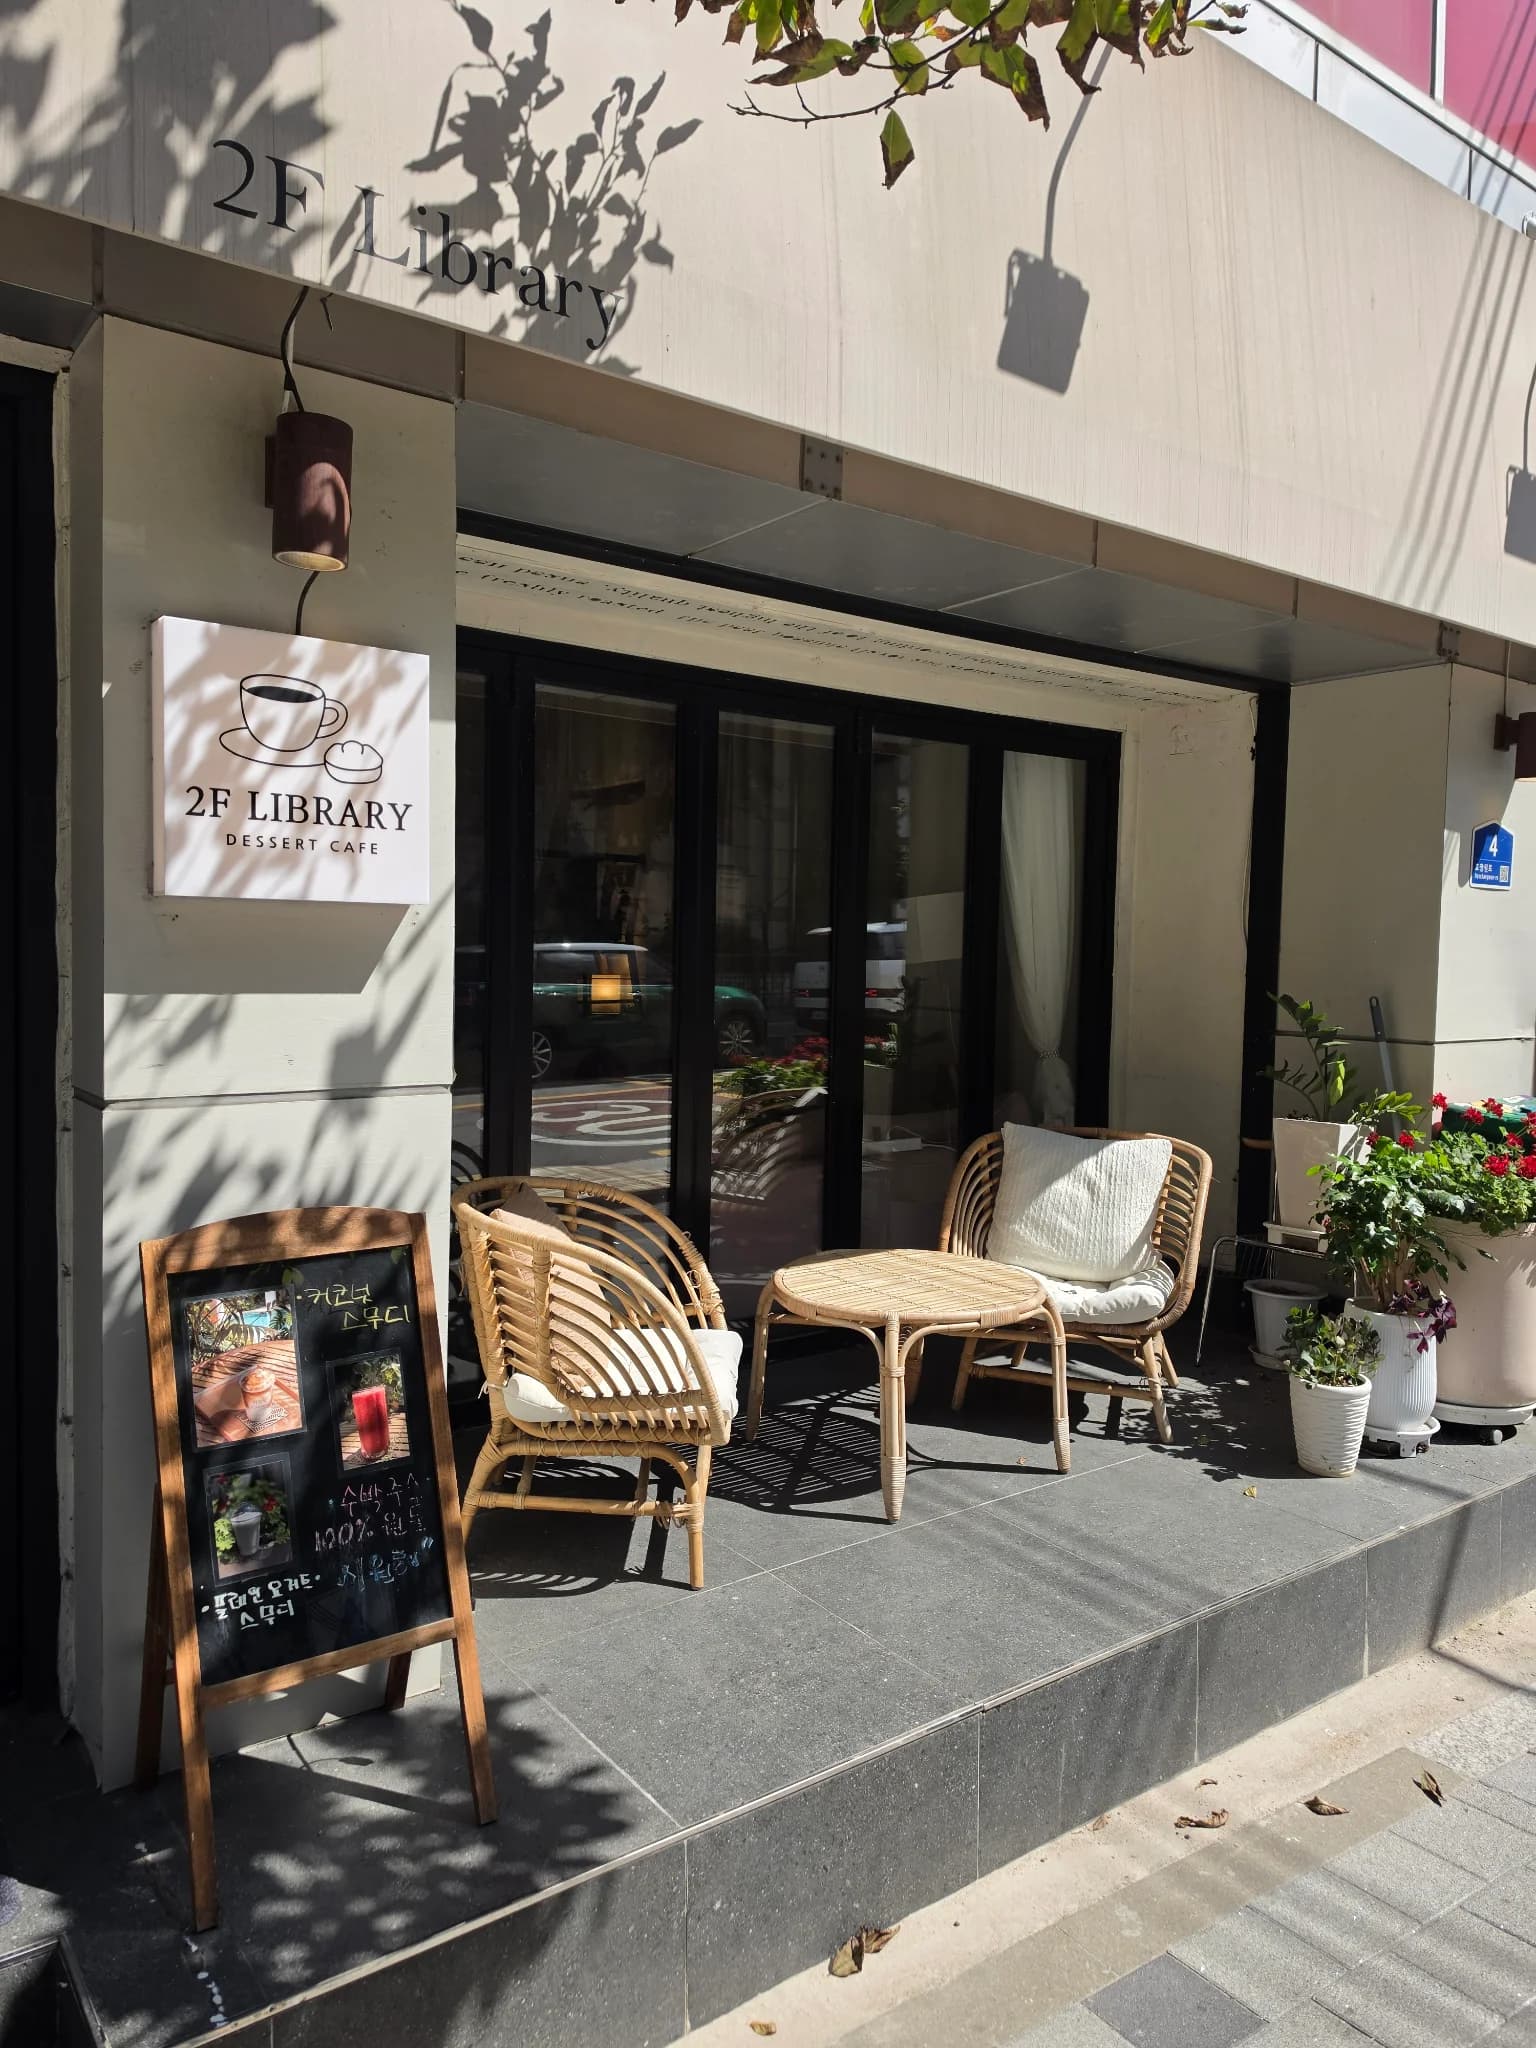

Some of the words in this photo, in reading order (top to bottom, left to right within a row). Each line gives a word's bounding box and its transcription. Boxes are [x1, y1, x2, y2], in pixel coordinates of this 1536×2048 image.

[213, 139, 326, 232] 2F
[353, 185, 625, 350] Library
[185, 785, 231, 818] 2F
[247, 790, 413, 831] LIBRARY
[226, 833, 317, 852] DESSERT
[330, 839, 379, 855] CAFE
[1489, 834, 1498, 857] 4
[341, 1304, 411, 1331] 스무디
[240, 1599, 295, 1631] 스무디
